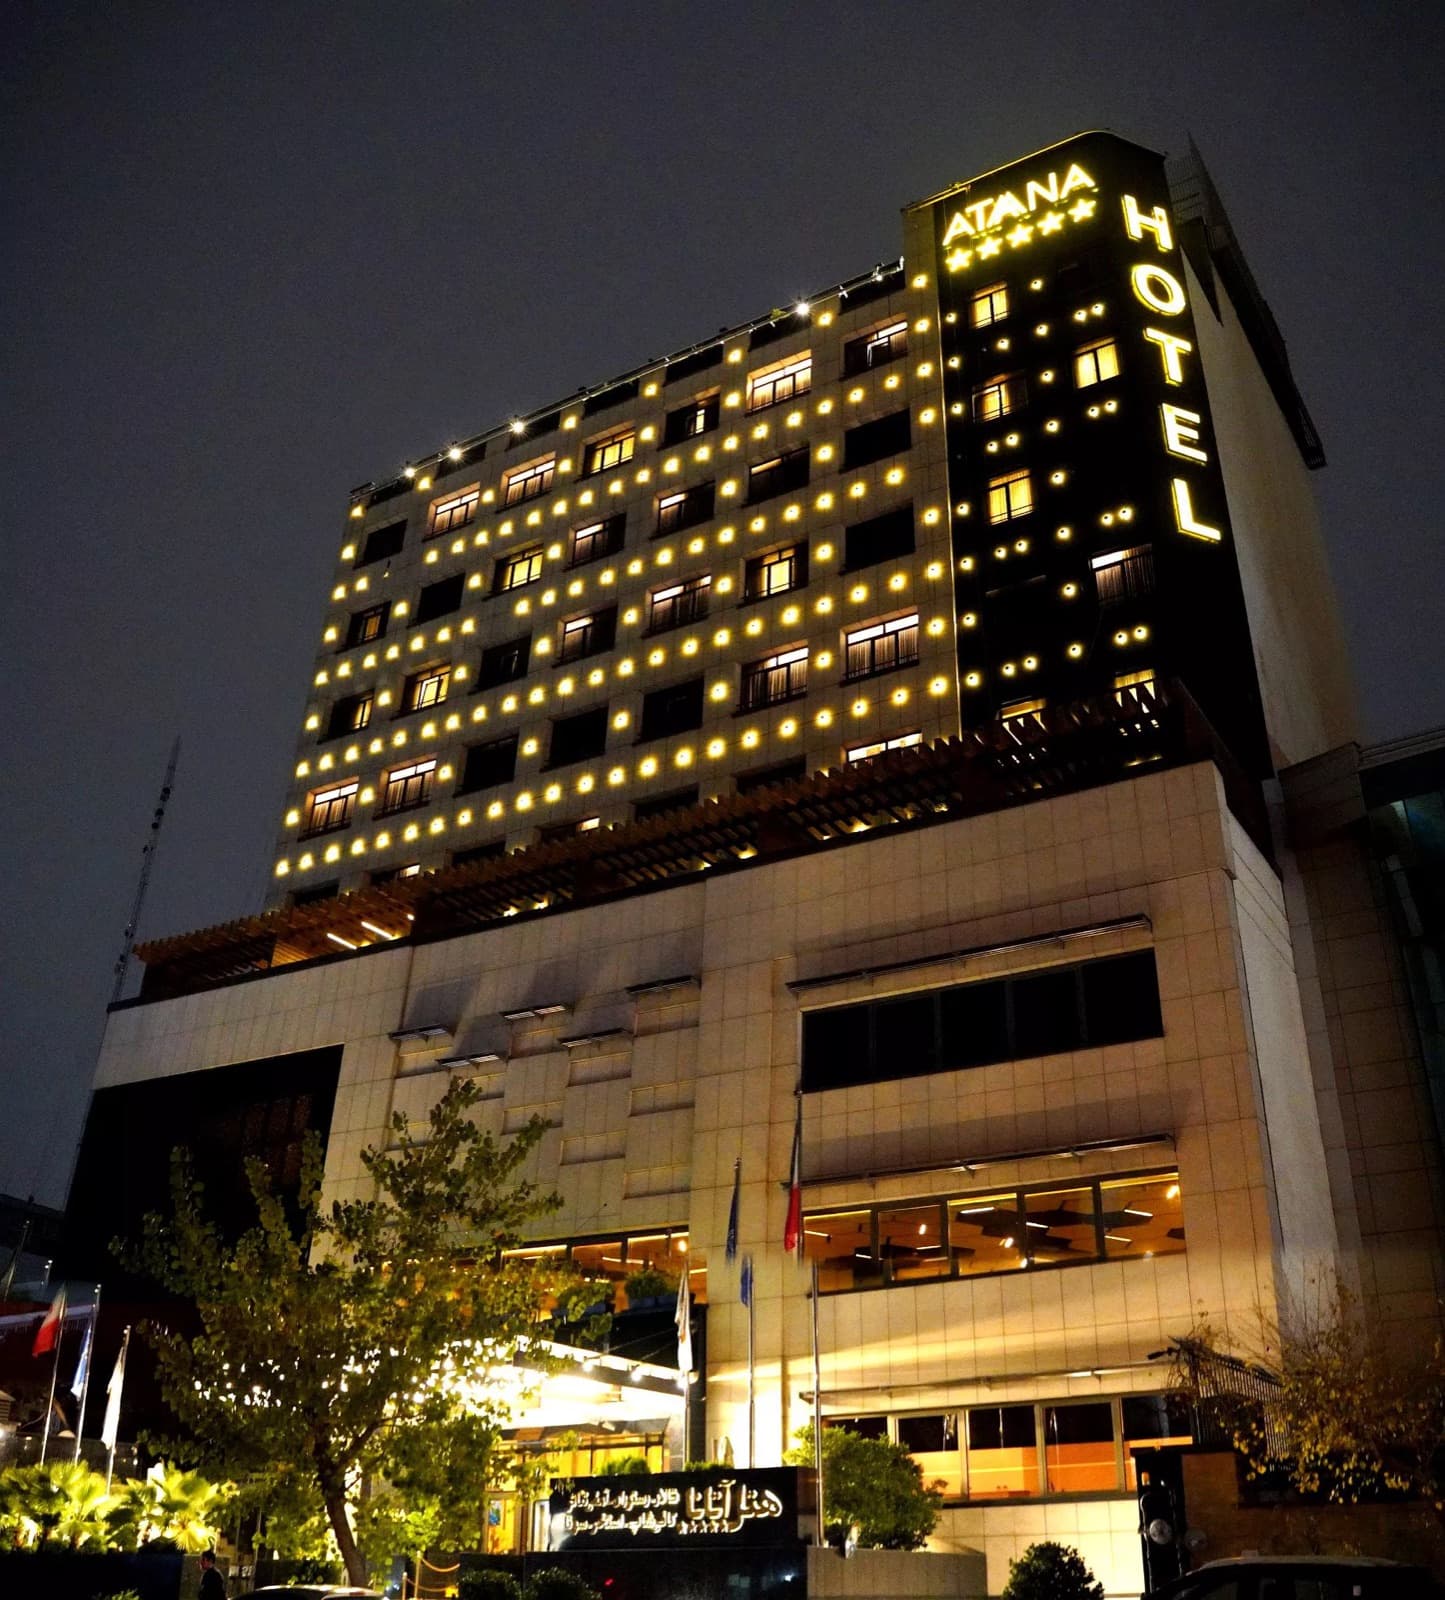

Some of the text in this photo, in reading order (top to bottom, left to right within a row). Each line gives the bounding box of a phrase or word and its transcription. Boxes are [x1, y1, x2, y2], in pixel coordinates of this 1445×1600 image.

[943, 163, 1096, 247] ATANA
[1121, 193, 1222, 542] HOTEL
[687, 1479, 783, 1533] هتل آتانا
